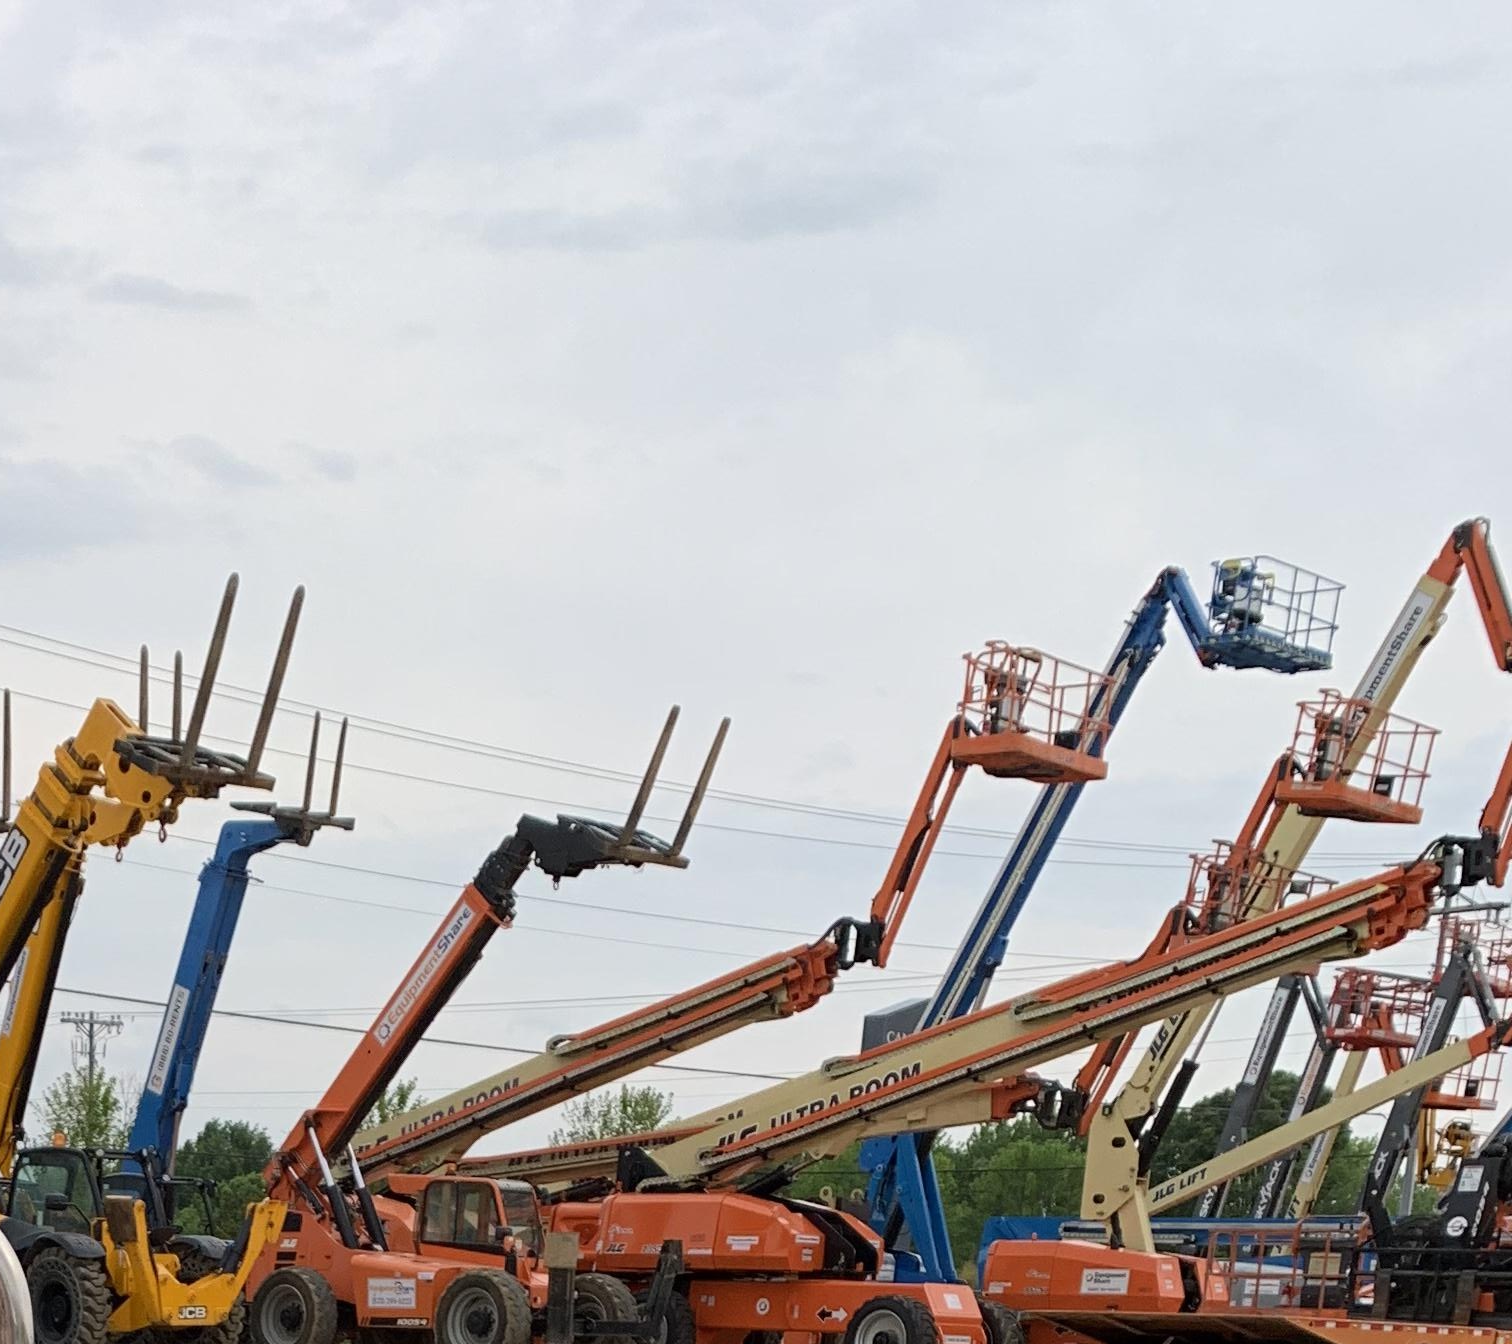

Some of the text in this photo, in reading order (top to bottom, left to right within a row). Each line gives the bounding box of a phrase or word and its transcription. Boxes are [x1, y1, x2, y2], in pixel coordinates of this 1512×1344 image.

[388, 908, 472, 1025] EquipmentShare
[1152, 1168, 1207, 1202] JLG LIFT
[178, 1307, 206, 1319] JCB
